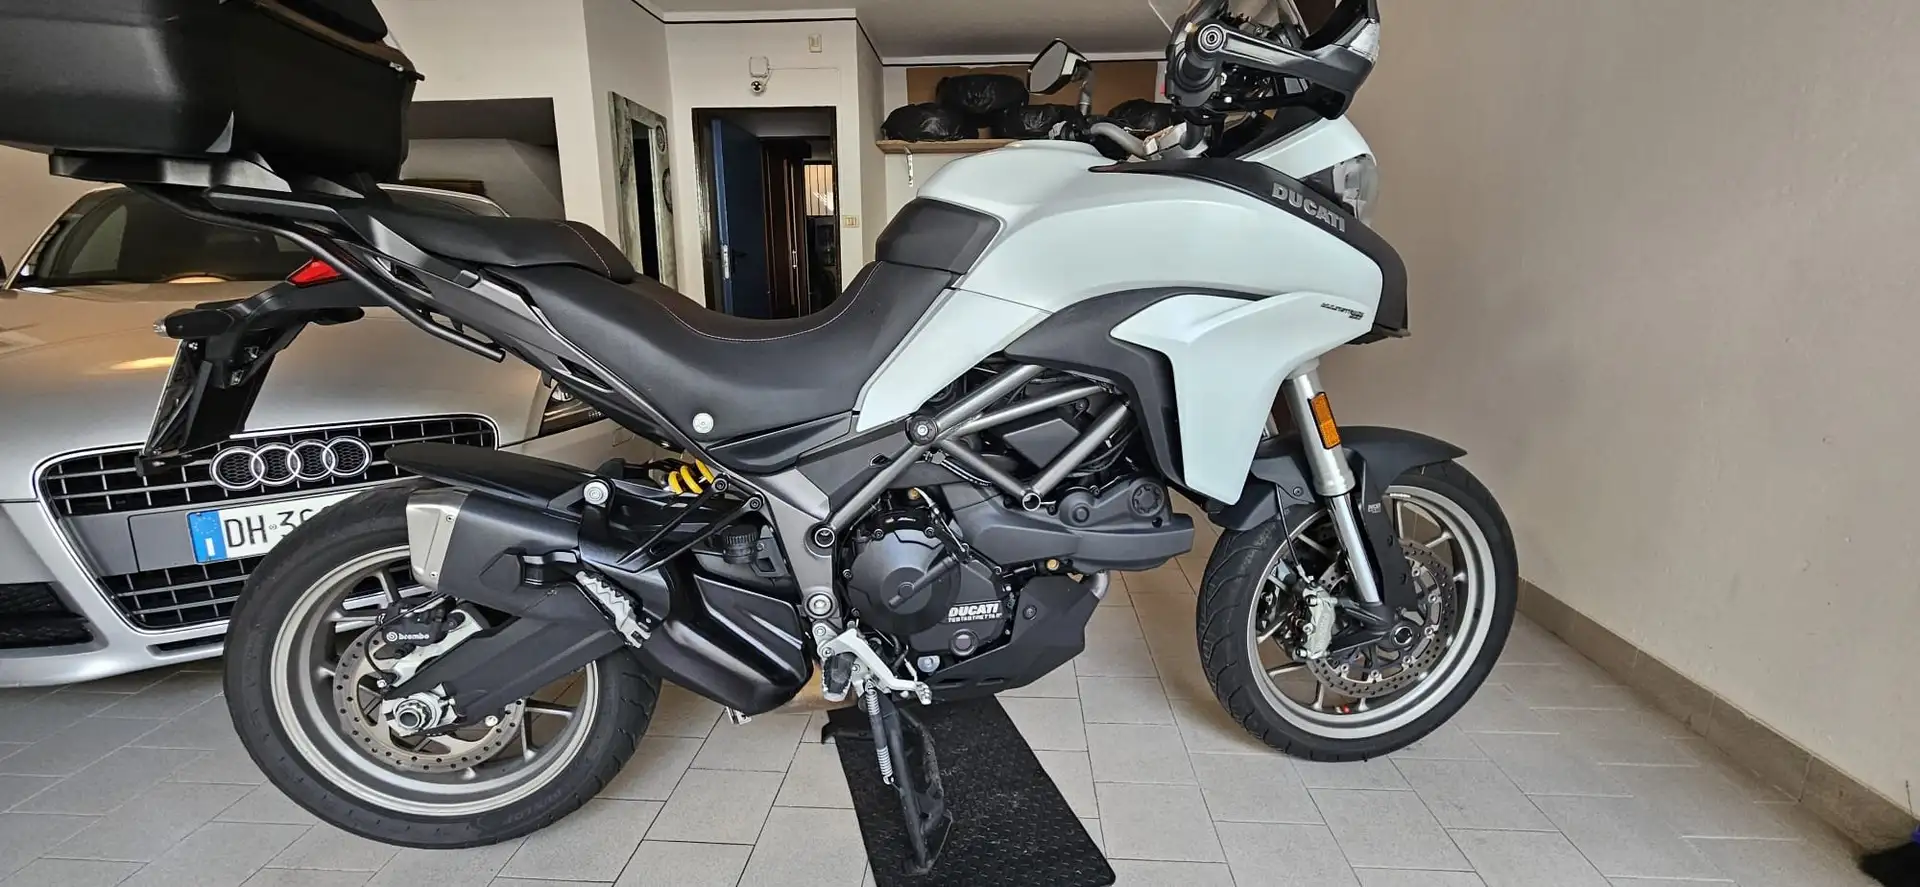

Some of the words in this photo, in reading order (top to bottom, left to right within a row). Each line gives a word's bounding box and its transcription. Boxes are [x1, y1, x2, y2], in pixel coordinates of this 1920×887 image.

[1271, 182, 1346, 233] DUCATI
[223, 514, 268, 548] DH
[948, 602, 999, 617] DUCATI
[398, 632, 430, 640] brembo
